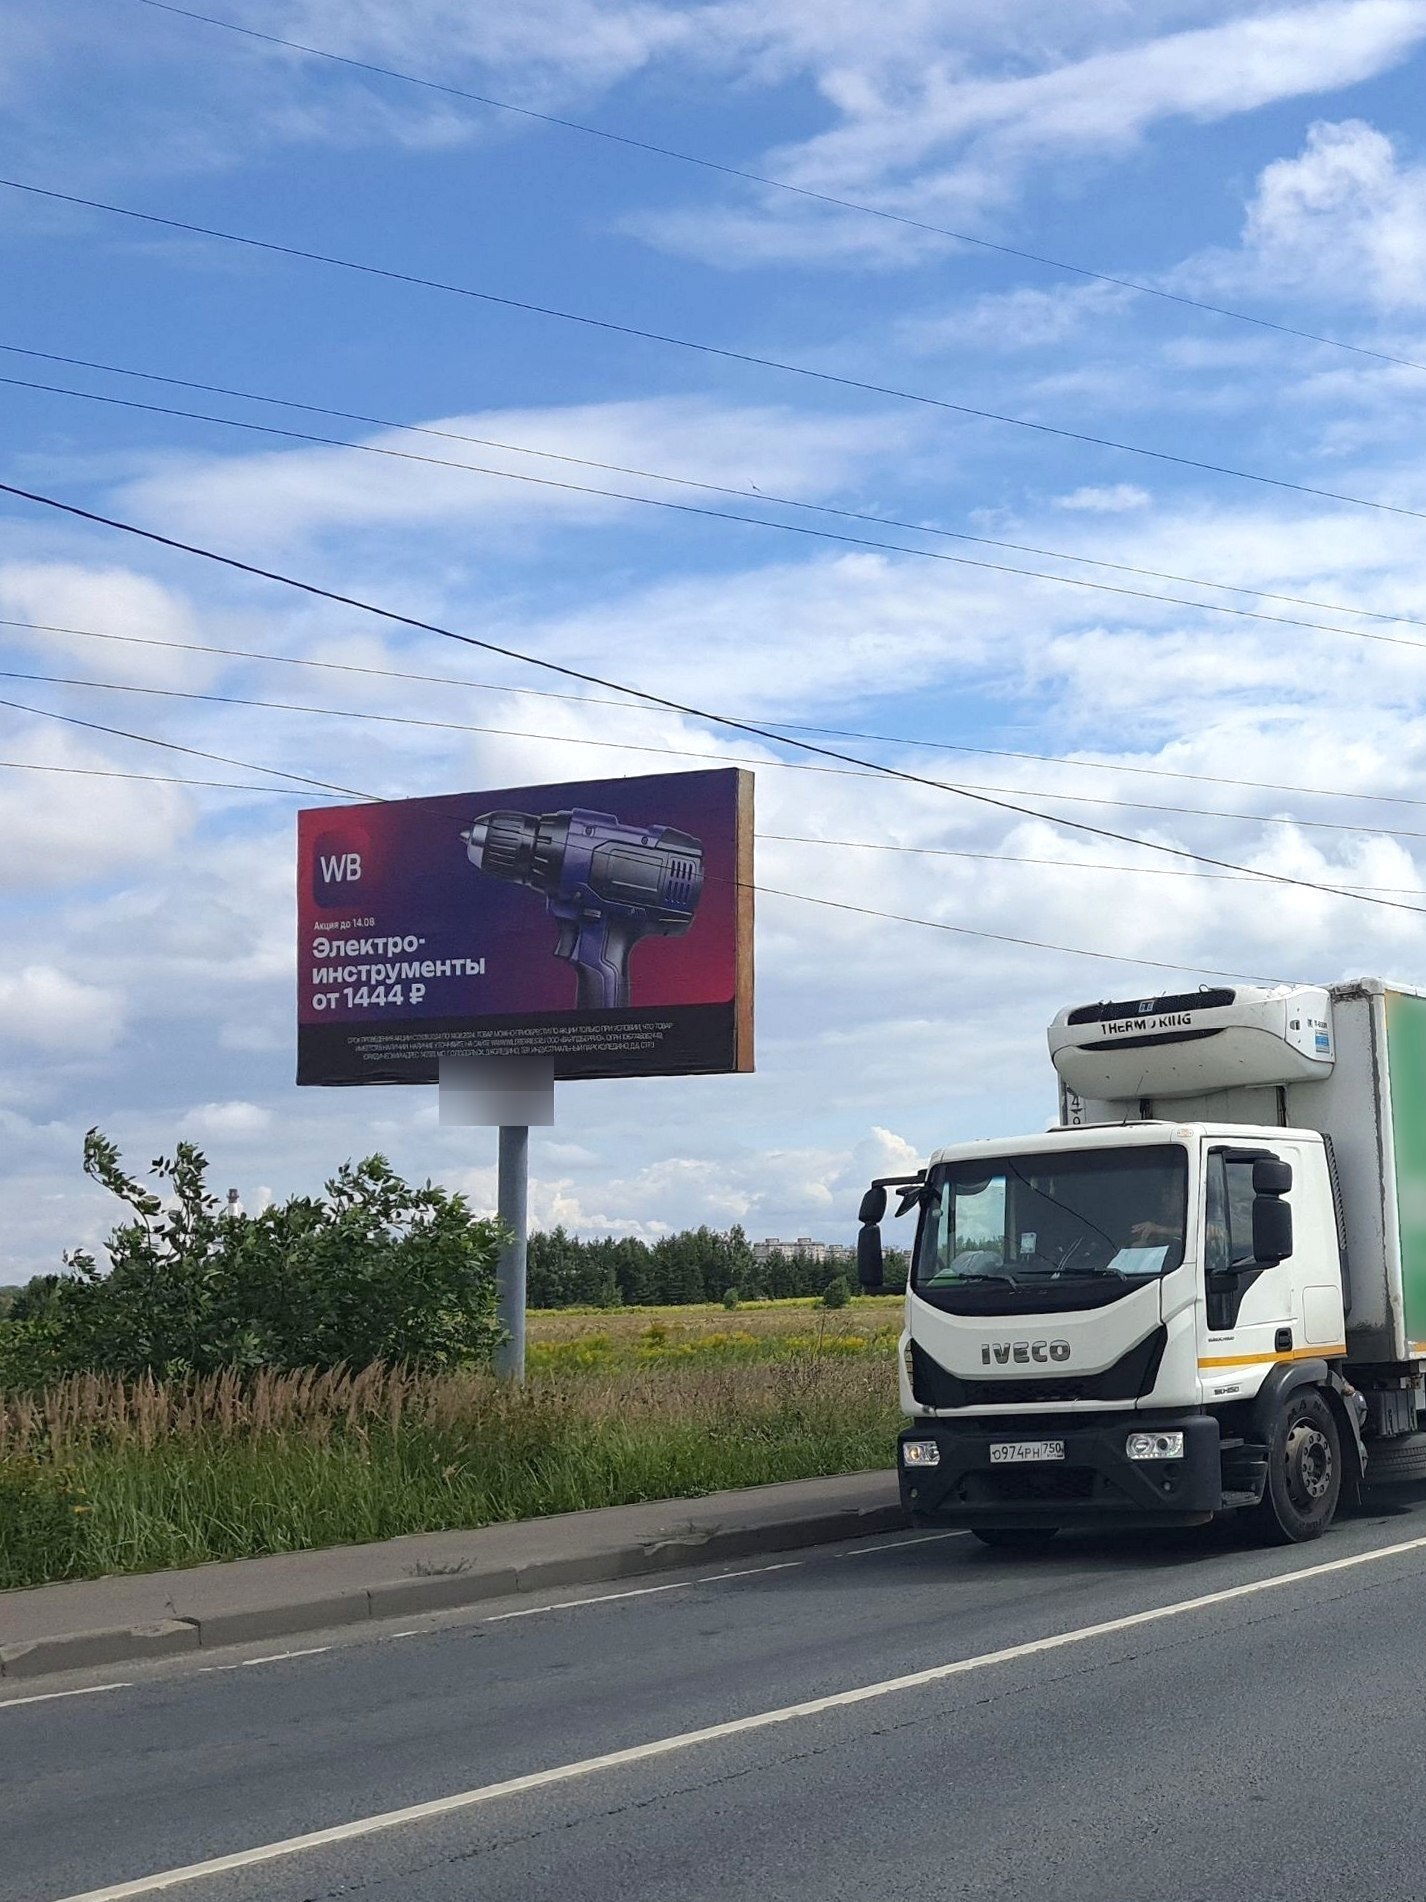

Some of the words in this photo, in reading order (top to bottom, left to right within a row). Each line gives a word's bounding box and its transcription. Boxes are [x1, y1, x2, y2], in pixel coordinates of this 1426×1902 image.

[320, 853, 362, 883] WB
[314, 920, 339, 931] Акция
[340, 919, 351, 930] до
[312, 935, 426, 958] Электро-
[312, 958, 486, 985] инструменты
[312, 992, 340, 1011] от
[343, 984, 403, 1008] 1444
[980, 1339, 1071, 1365] IVECO
